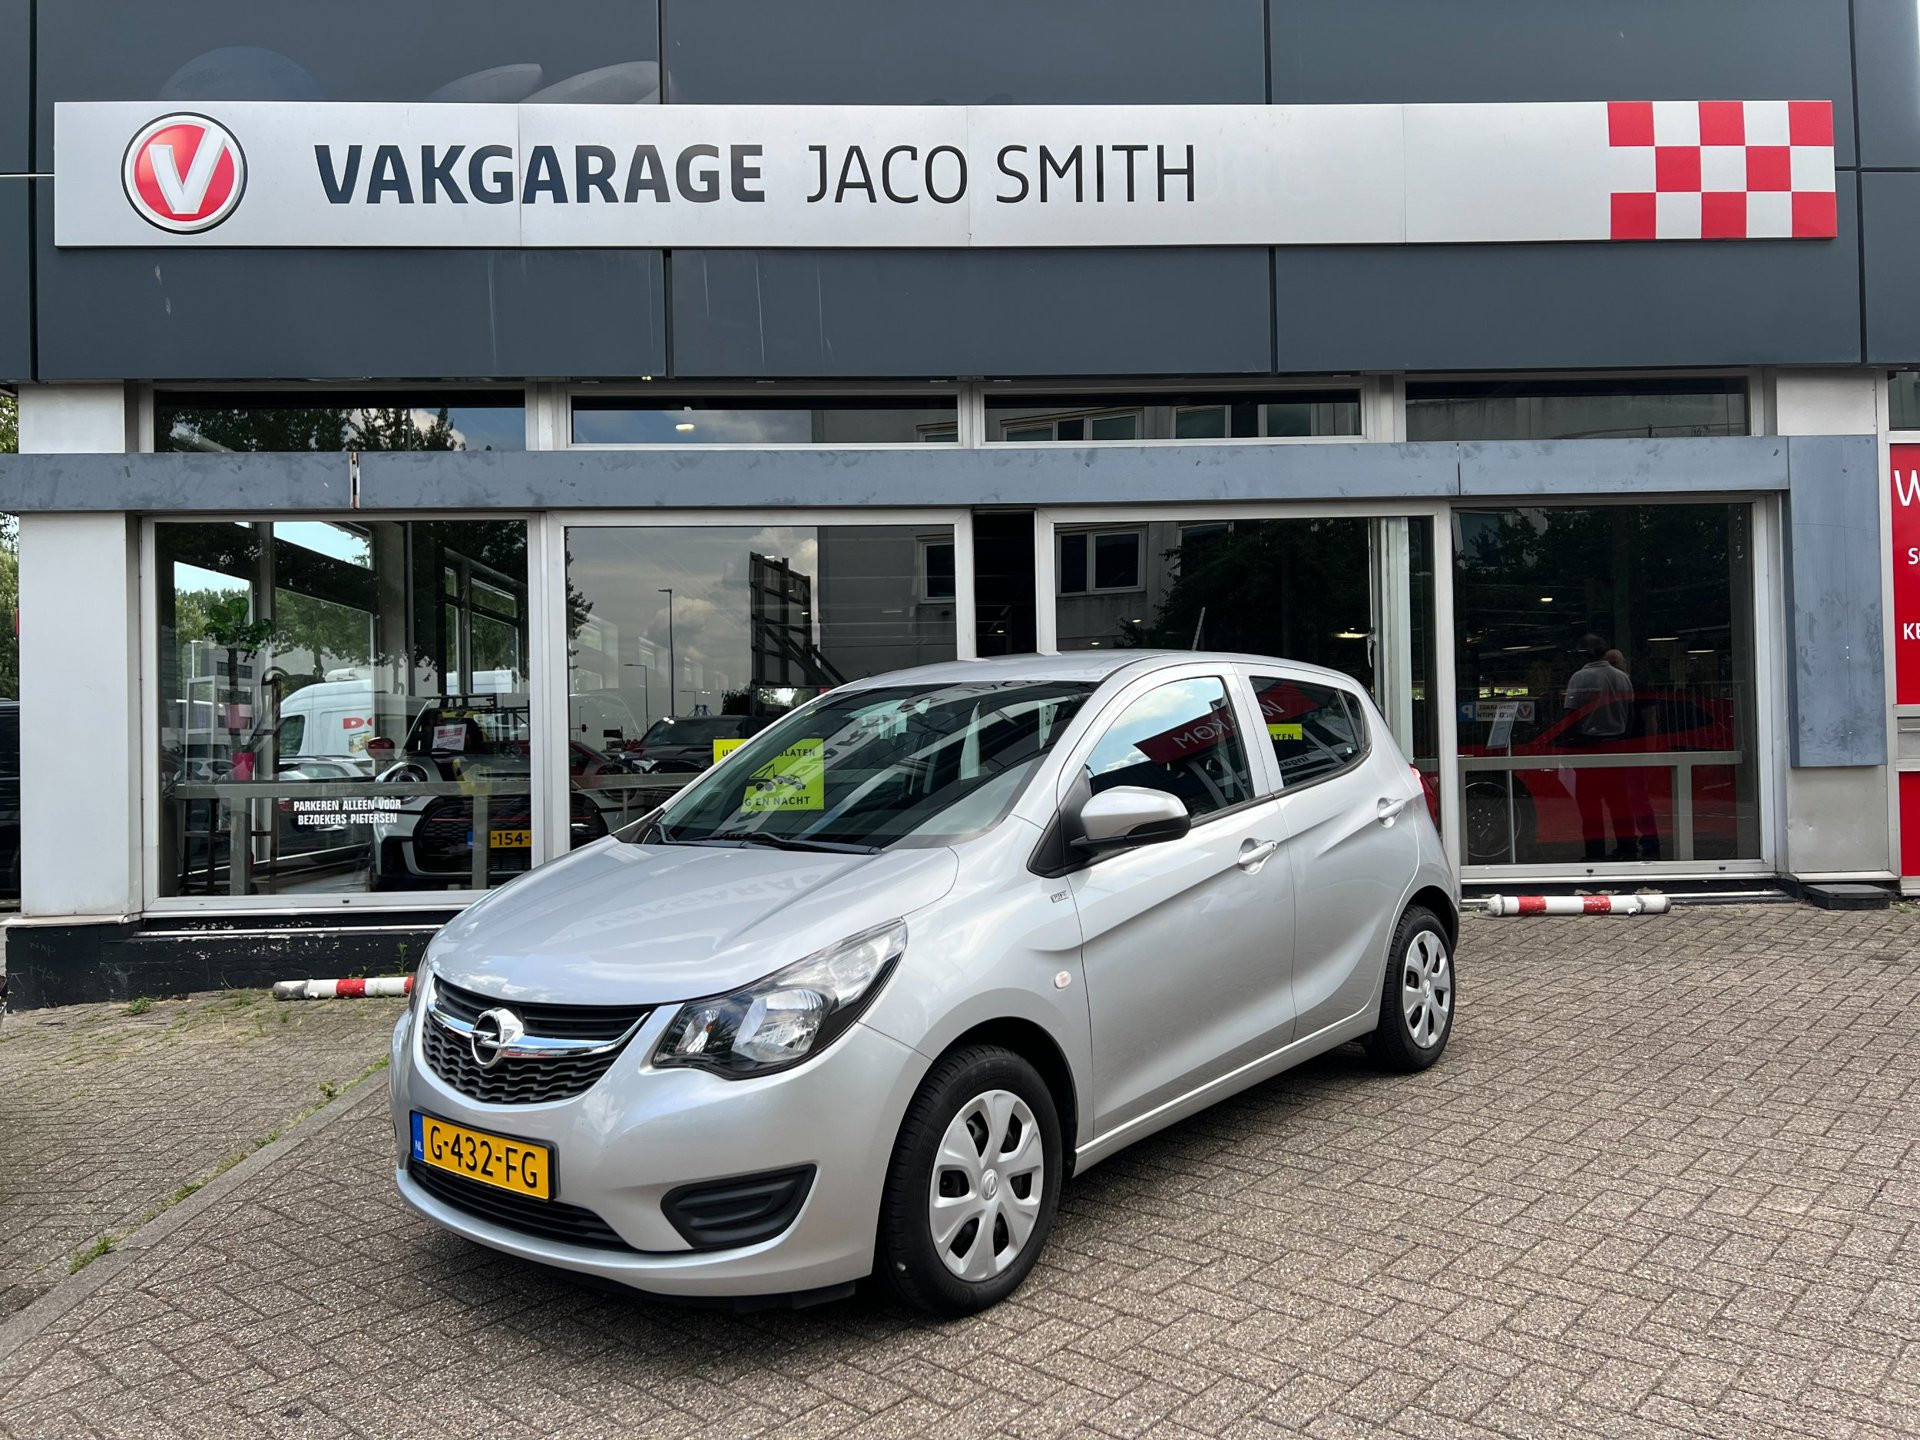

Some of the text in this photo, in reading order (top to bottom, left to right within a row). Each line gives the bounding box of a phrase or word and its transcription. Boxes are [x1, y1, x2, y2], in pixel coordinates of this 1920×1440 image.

[314, 144, 766, 204] VAKGARAGE
[806, 145, 968, 204] JACO
[996, 145, 1195, 204] SMITH
[1908, 547, 1920, 565] S
[293, 799, 402, 811] PARKEREN ALLEEN VOOR
[756, 797, 769, 805] EN
[774, 796, 811, 805] NACHT
[298, 813, 398, 825] BEZOEKERS PIETERSEN
[492, 832, 531, 846] -154-
[415, 1140, 423, 1152] NL
[430, 1126, 538, 1189] G-432-FG
